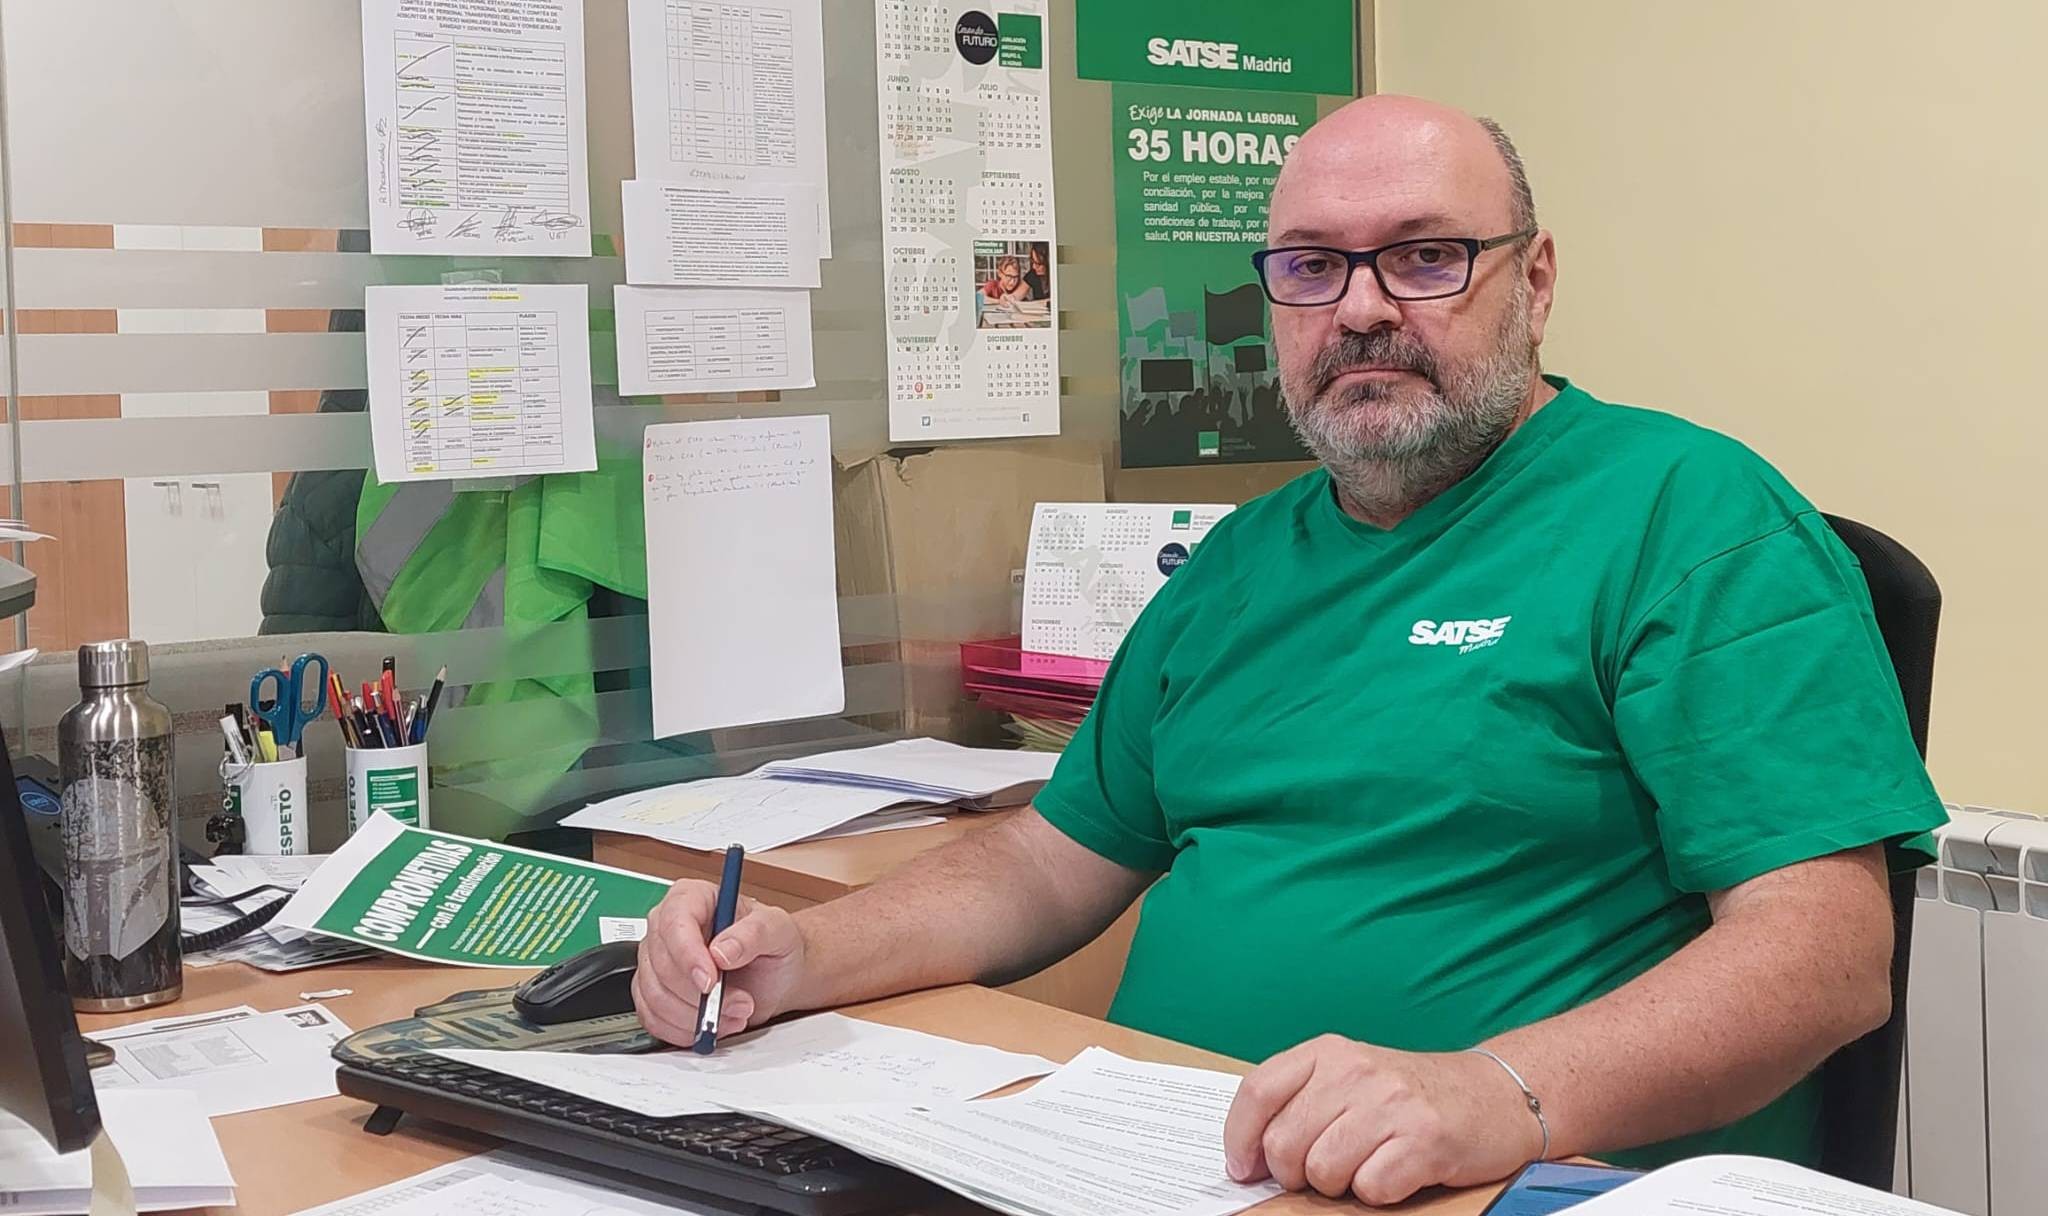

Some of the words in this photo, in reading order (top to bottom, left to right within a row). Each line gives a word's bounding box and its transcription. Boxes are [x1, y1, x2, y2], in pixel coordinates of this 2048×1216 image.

[962, 35, 998, 48] FUTURO
[1147, 38, 1239, 70] SATSE
[1243, 55, 1292, 73] Madrid
[887, 75, 909, 83] JUNIO
[978, 83, 998, 91] JULIO
[1128, 104, 1164, 125] Exige
[1166, 107, 1182, 120] LA
[1186, 109, 1243, 123] JORNADA
[1247, 112, 1299, 125] LABORAL
[1128, 128, 1171, 161] 35
[890, 168, 920, 176] AGOSTO
[1143, 171, 1158, 182] Por
[1162, 172, 1170, 183] el
[1174, 172, 1206, 186] empleo
[1209, 174, 1242, 186] estable,
[1245, 176, 1259, 188] por
[1143, 186, 1196, 199] conciliación,
[1202, 188, 1216, 200] por
[1222, 187, 1230, 198] la
[1235, 190, 1264, 201] mejora
[1144, 201, 1178, 213] sanidad
[1190, 202, 1222, 215] pública,
[1234, 205, 1248, 216] por
[1144, 216, 1195, 228] condiciones
[1198, 217, 1209, 227] de
[1212, 217, 1243, 230] trabajo,
[1246, 220, 1260, 230] por
[1145, 230, 1170, 242] salud,
[1173, 231, 1193, 241] POR
[1196, 231, 1240, 242] NUESTRA
[1408, 616, 1512, 645] SATSE
[352, 840, 473, 942] COMPROMETIDAS
[430, 911, 455, 929] con
[445, 852, 504, 903] transformación
